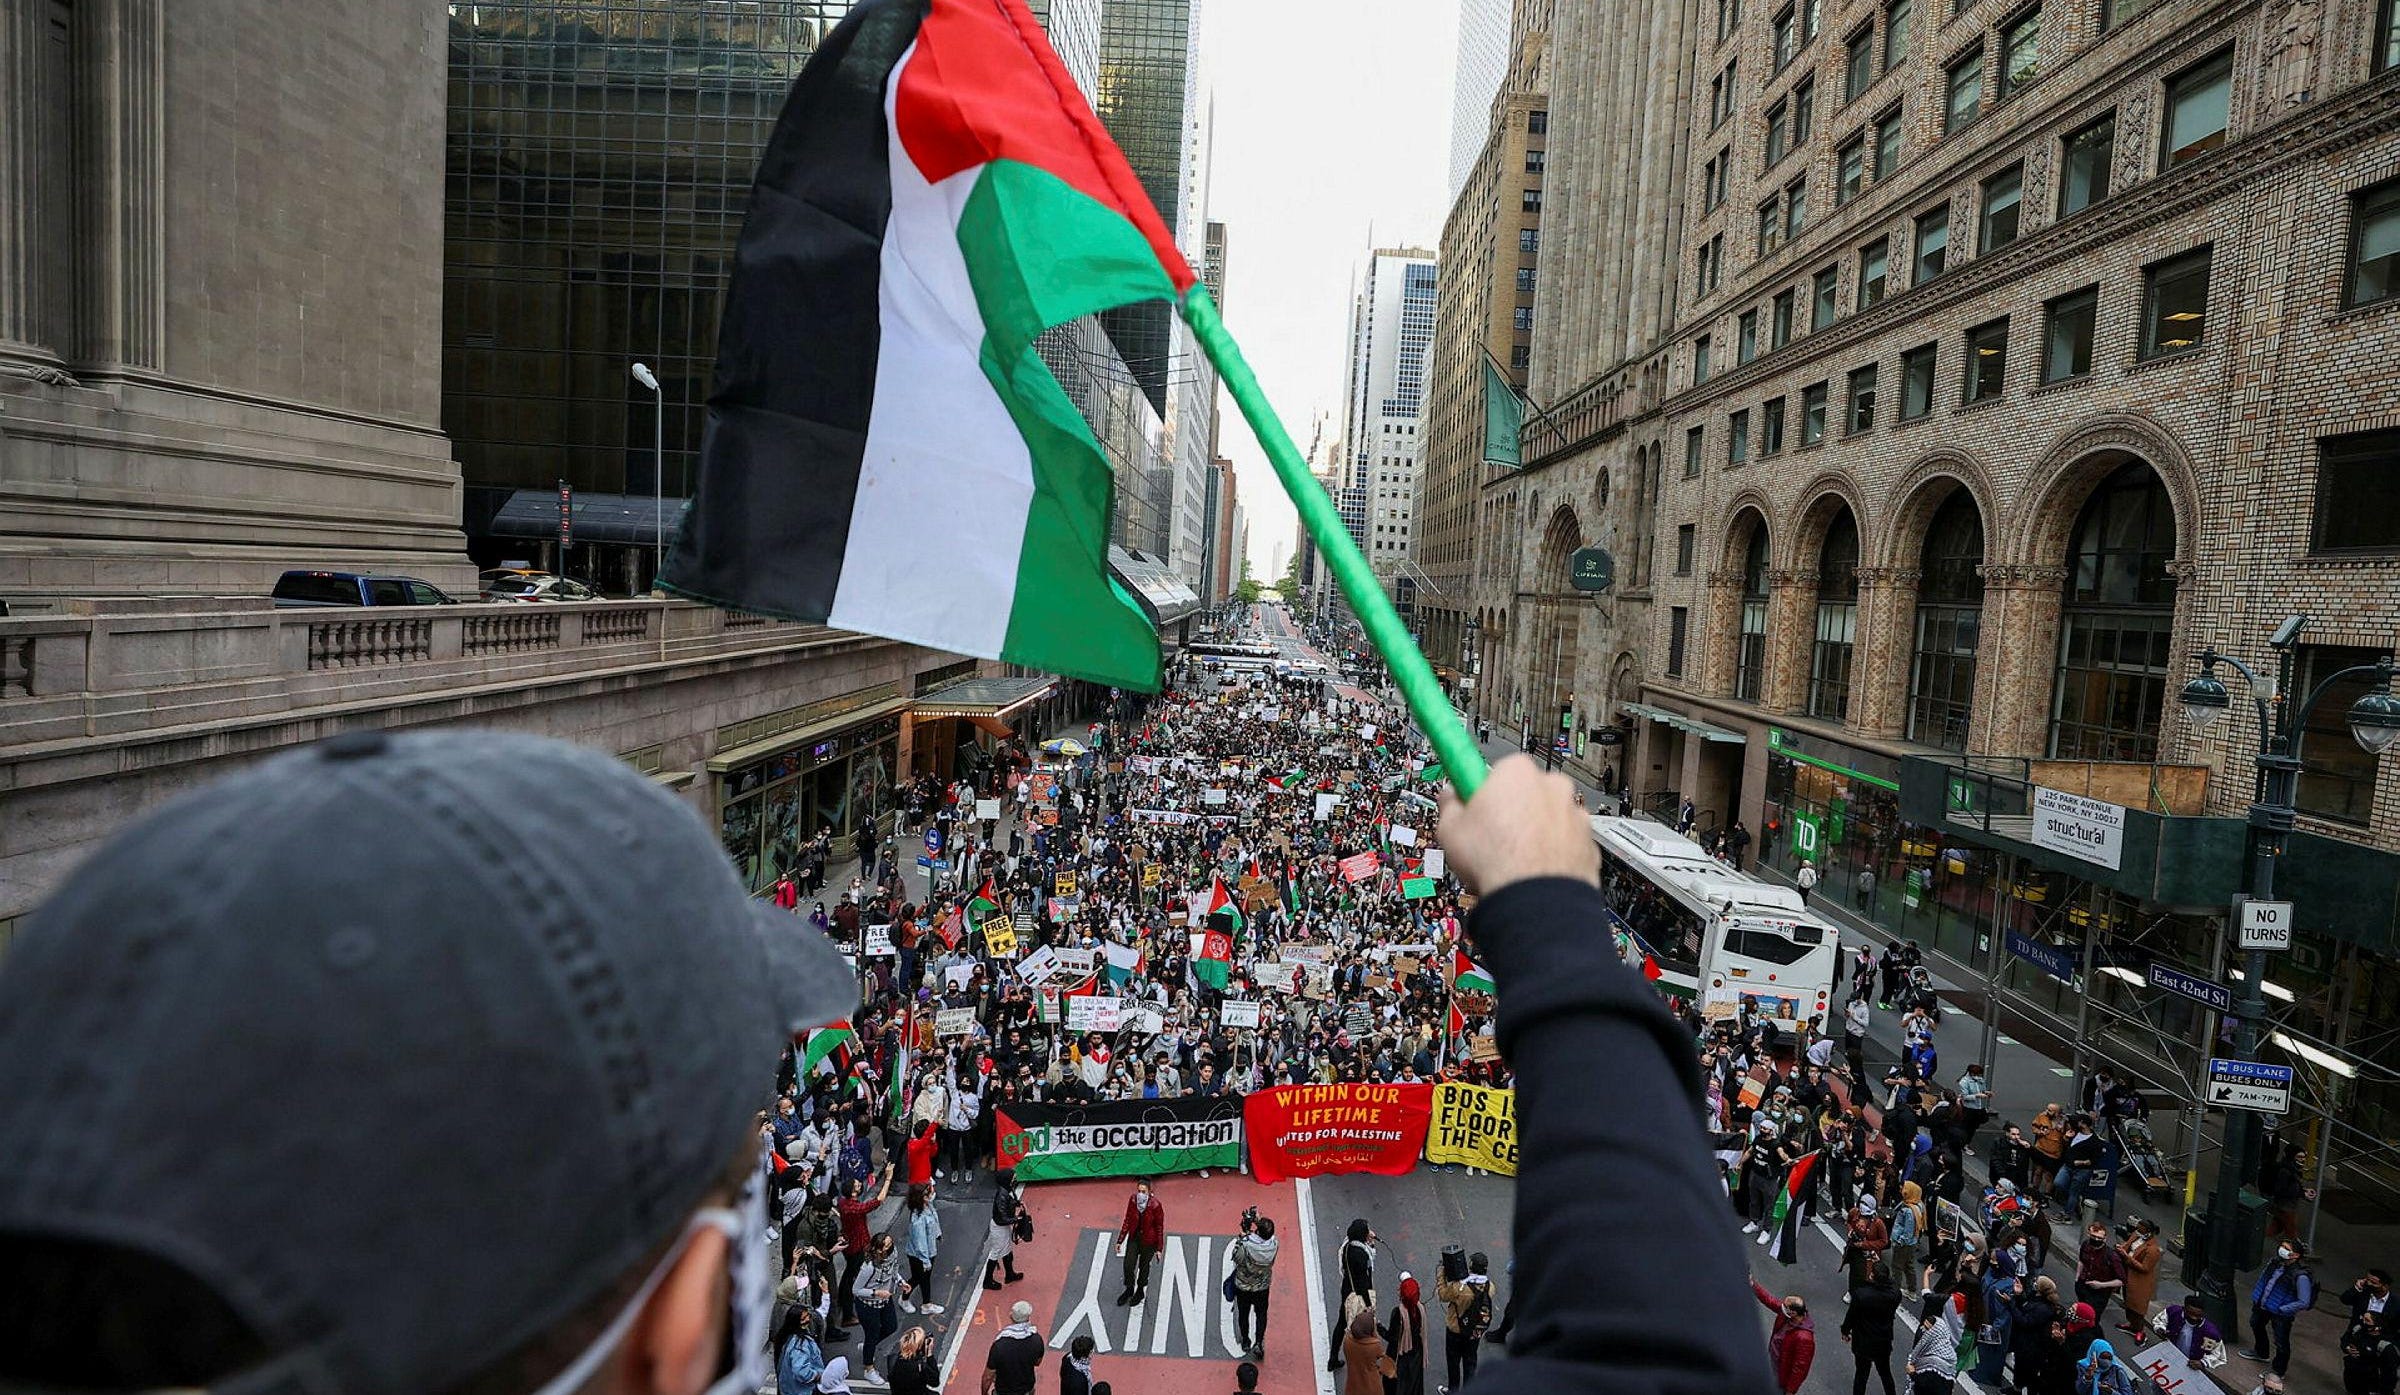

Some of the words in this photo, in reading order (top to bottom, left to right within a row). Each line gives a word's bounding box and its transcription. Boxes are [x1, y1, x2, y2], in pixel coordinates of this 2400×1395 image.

[2038, 798, 2056, 808] NEW
[2081, 809, 2093, 818] NY
[2095, 812, 2119, 825] 10017
[2045, 790, 2059, 801] 125
[2059, 794, 2079, 806] PARK
[2081, 799, 2112, 815] AVENUE
[1797, 818, 1817, 851] TD
[985, 917, 1009, 934] FREE
[2256, 909, 2277, 924] NO
[2244, 928, 2288, 942] TURNS
[2015, 938, 2029, 955] TD
[2031, 946, 2060, 971] BANK
[2154, 969, 2178, 989] East
[2180, 981, 2209, 1000] 42nd
[2211, 990, 2226, 1006] St
[2215, 1073, 2251, 1085] BUSES
[2254, 1078, 2283, 1088] ONLY
[2232, 1064, 2254, 1074] BUS
[2256, 1067, 2286, 1078] LANE
[1275, 1085, 1348, 1108] WITHIN
[1354, 1084, 1400, 1105] OUR
[1444, 1086, 1488, 1112] BDS
[1292, 1107, 1382, 1127] LIFETIME
[1441, 1107, 1512, 1140] FLOOR
[1002, 1122, 1050, 1155] end
[1056, 1128, 1085, 1146] the
[1092, 1119, 1234, 1152] occupation
[1315, 1128, 1338, 1140] FOR
[1341, 1129, 1403, 1142] PALESTINE
[1439, 1127, 1481, 1150] THE
